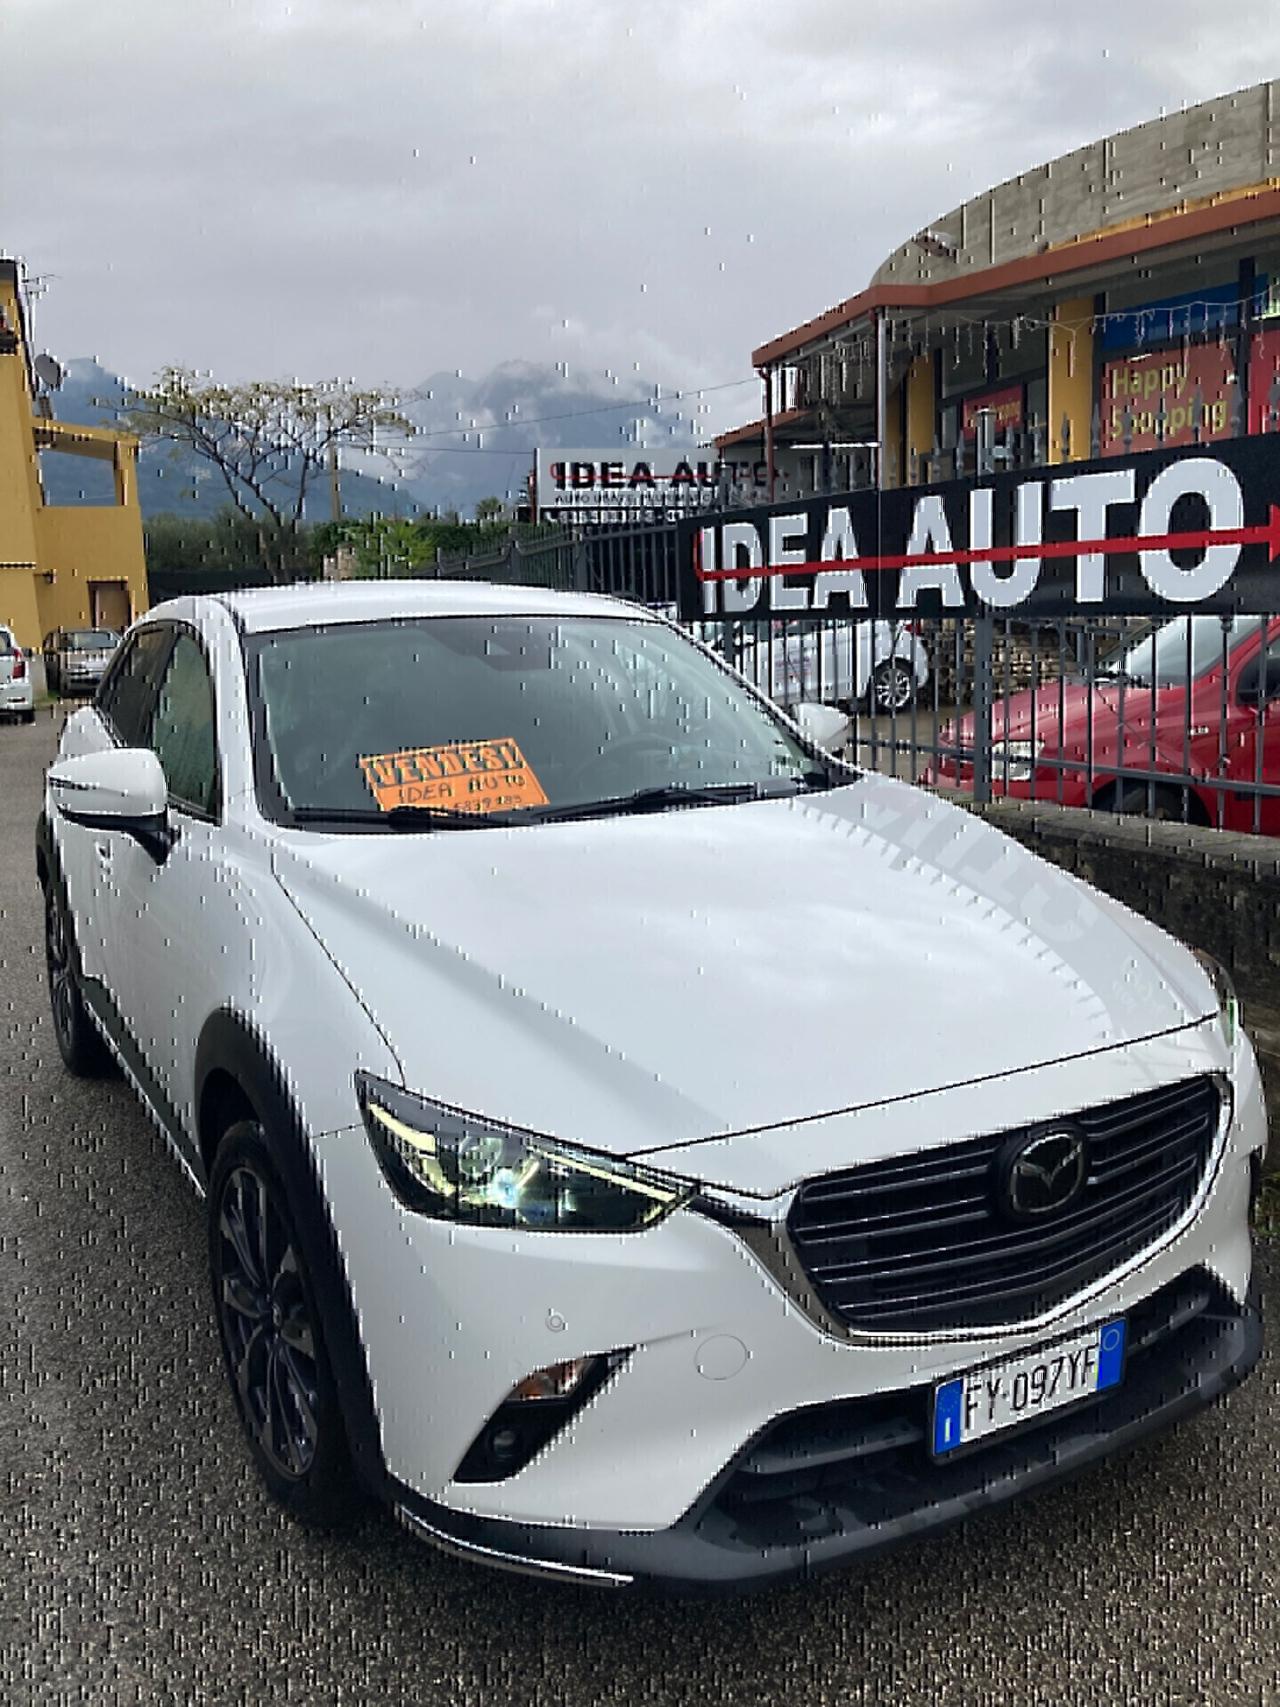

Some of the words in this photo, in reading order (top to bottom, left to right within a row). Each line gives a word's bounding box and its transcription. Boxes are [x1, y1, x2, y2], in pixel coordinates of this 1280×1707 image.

[1112, 364, 1189, 400] Happy
[553, 462, 655, 490] IDEA
[699, 507, 869, 614] IDEA
[895, 457, 1244, 608] AUTO
[399, 782, 452, 804] IDEA
